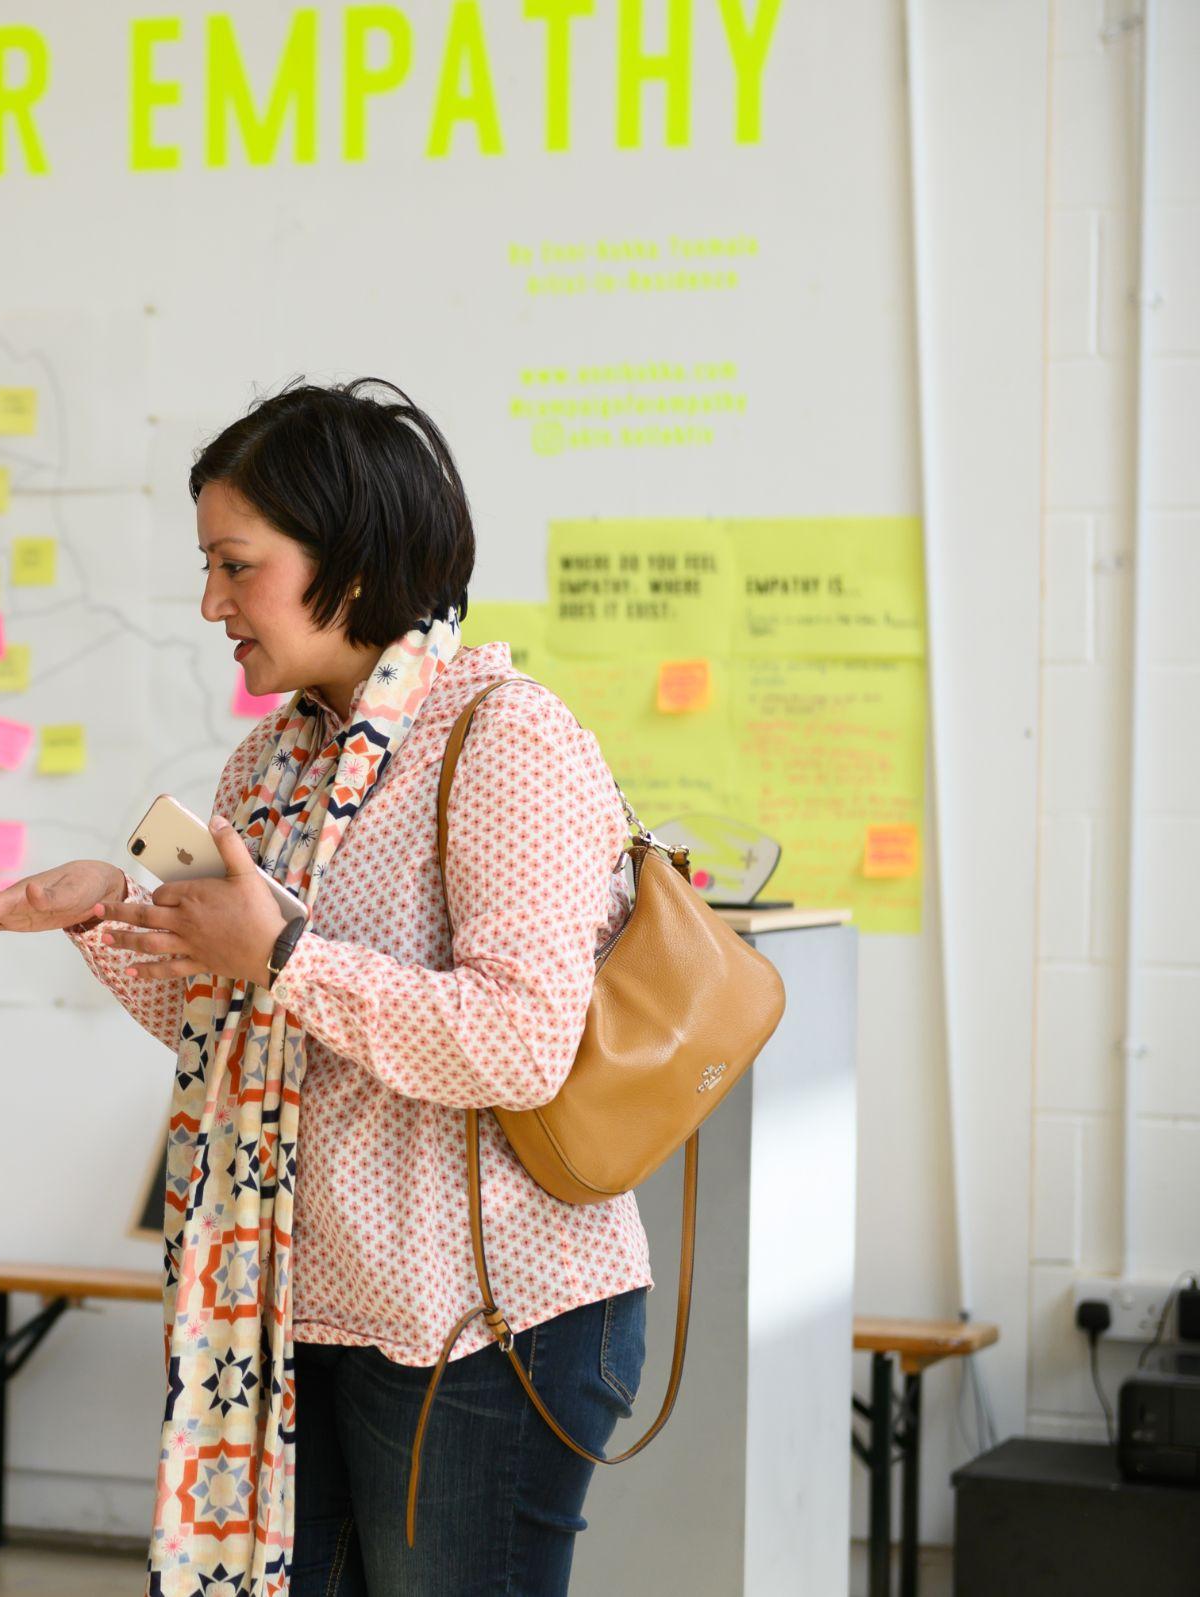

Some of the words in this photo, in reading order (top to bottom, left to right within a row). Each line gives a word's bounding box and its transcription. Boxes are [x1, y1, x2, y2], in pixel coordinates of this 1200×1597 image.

[129, 0, 782, 172] EMPATHY
[560, 556, 609, 572] WHERE
[619, 556, 639, 572] DO
[648, 555, 676, 572] YOU
[650, 578, 701, 595] WHERE
[745, 575, 820, 597] EMPATHY
[559, 602, 596, 619] DOES
[603, 602, 619, 618] IT
